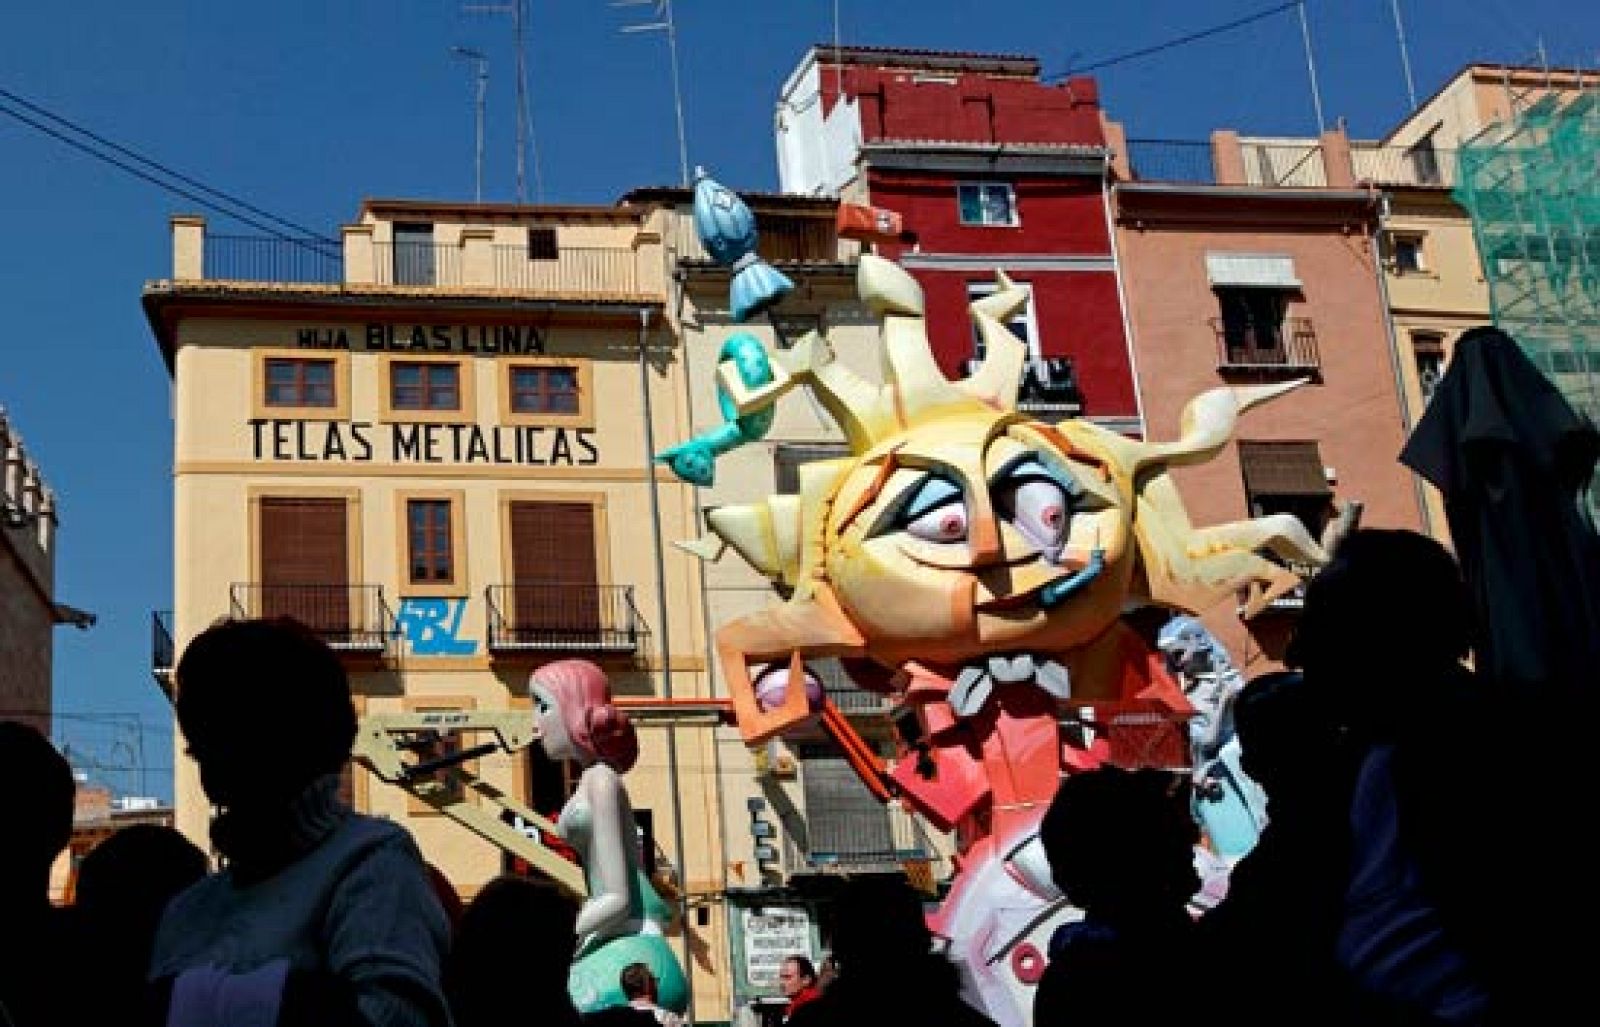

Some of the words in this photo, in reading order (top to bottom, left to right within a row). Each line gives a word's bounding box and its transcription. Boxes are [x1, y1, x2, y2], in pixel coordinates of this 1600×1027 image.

[298, 327, 350, 350] HIJA
[366, 324, 450, 350] BLAS
[462, 325, 544, 352] LUNA
[250, 420, 373, 461] TELAS
[392, 421, 599, 466] METALICAS
